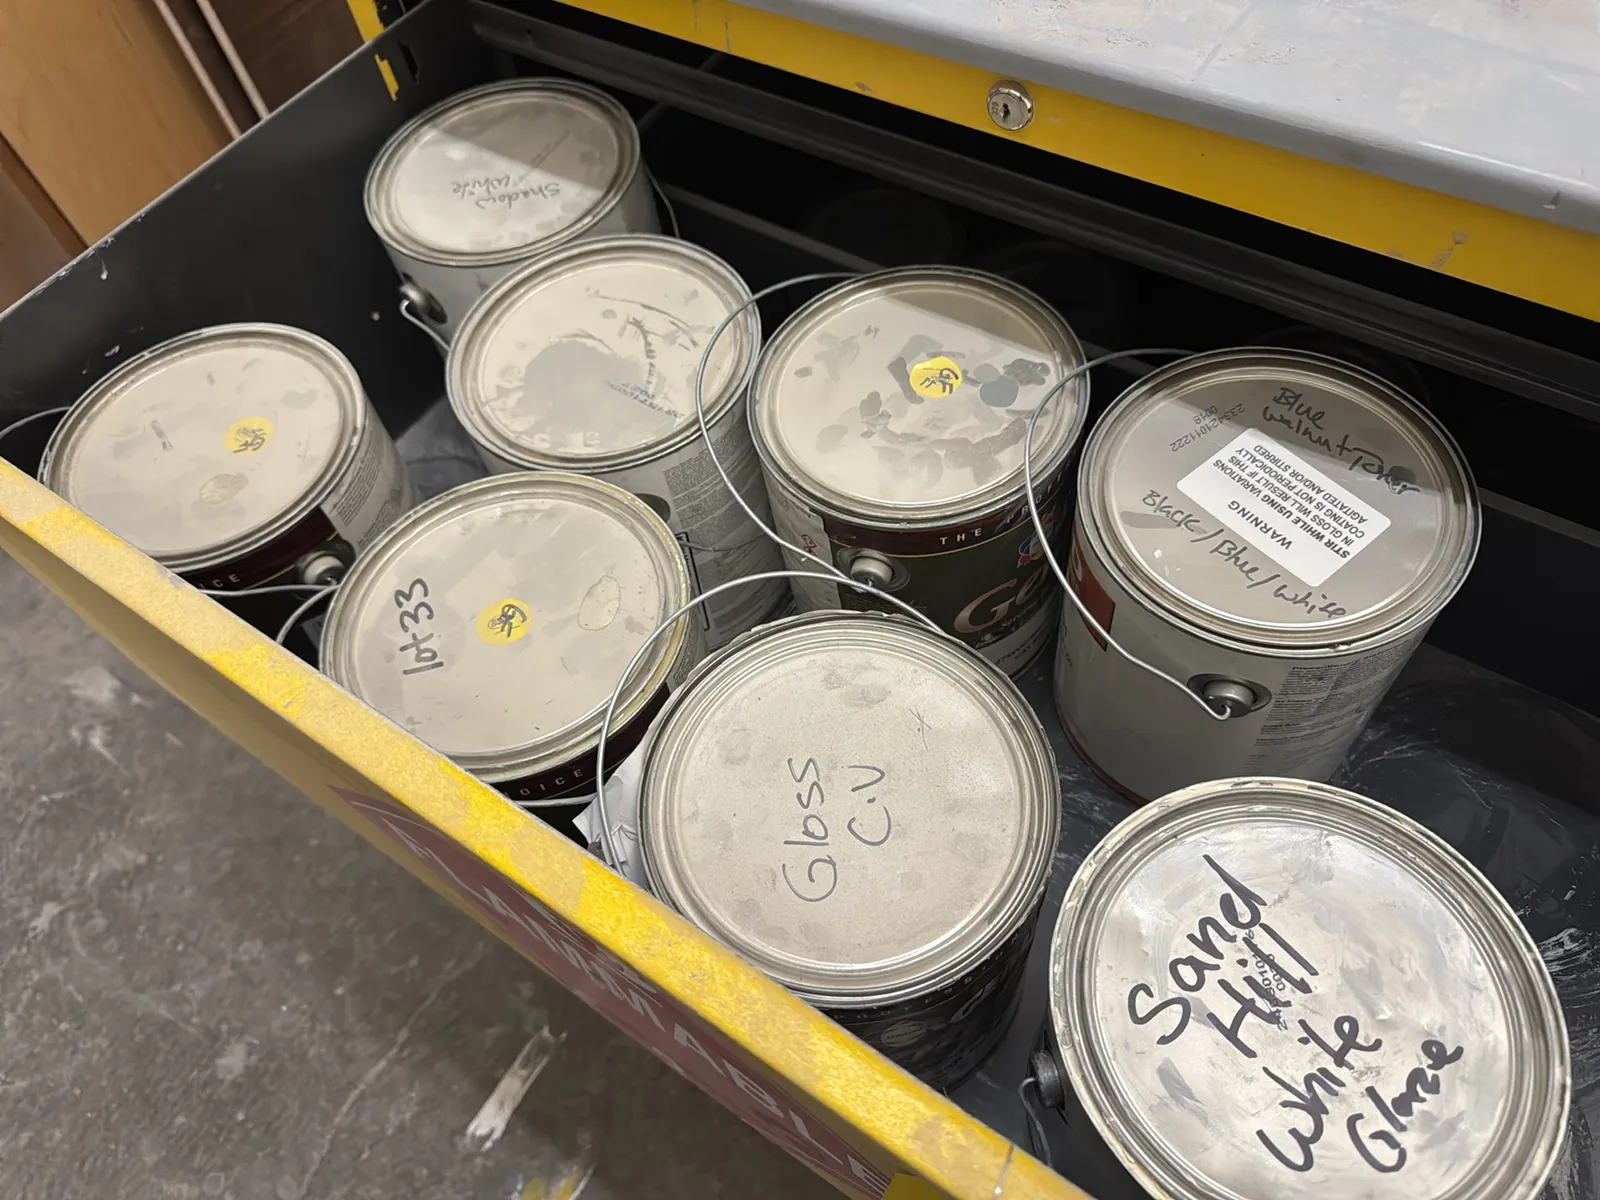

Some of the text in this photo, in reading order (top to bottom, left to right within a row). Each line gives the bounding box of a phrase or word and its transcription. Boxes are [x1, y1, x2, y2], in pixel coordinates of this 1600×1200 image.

[1273, 387, 1326, 430] Blue
[1213, 459, 1351, 559] STIR WHILE USING VARIATIONS
[1228, 455, 1355, 547] IN GLOSS WILL RESULT IF THIS
[1228, 500, 1293, 550] WARNING
[1235, 447, 1365, 539] COATING IS NOT PERIODICALLY
[1253, 444, 1368, 524] AGITATED AND/OR STIRRED
[940, 527, 982, 546] THE
[782, 757, 838, 903] Gloss
[1127, 853, 1268, 1046] Sand
[1206, 922, 1320, 1059] Hill
[1346, 1038, 1465, 1173] Glaze
